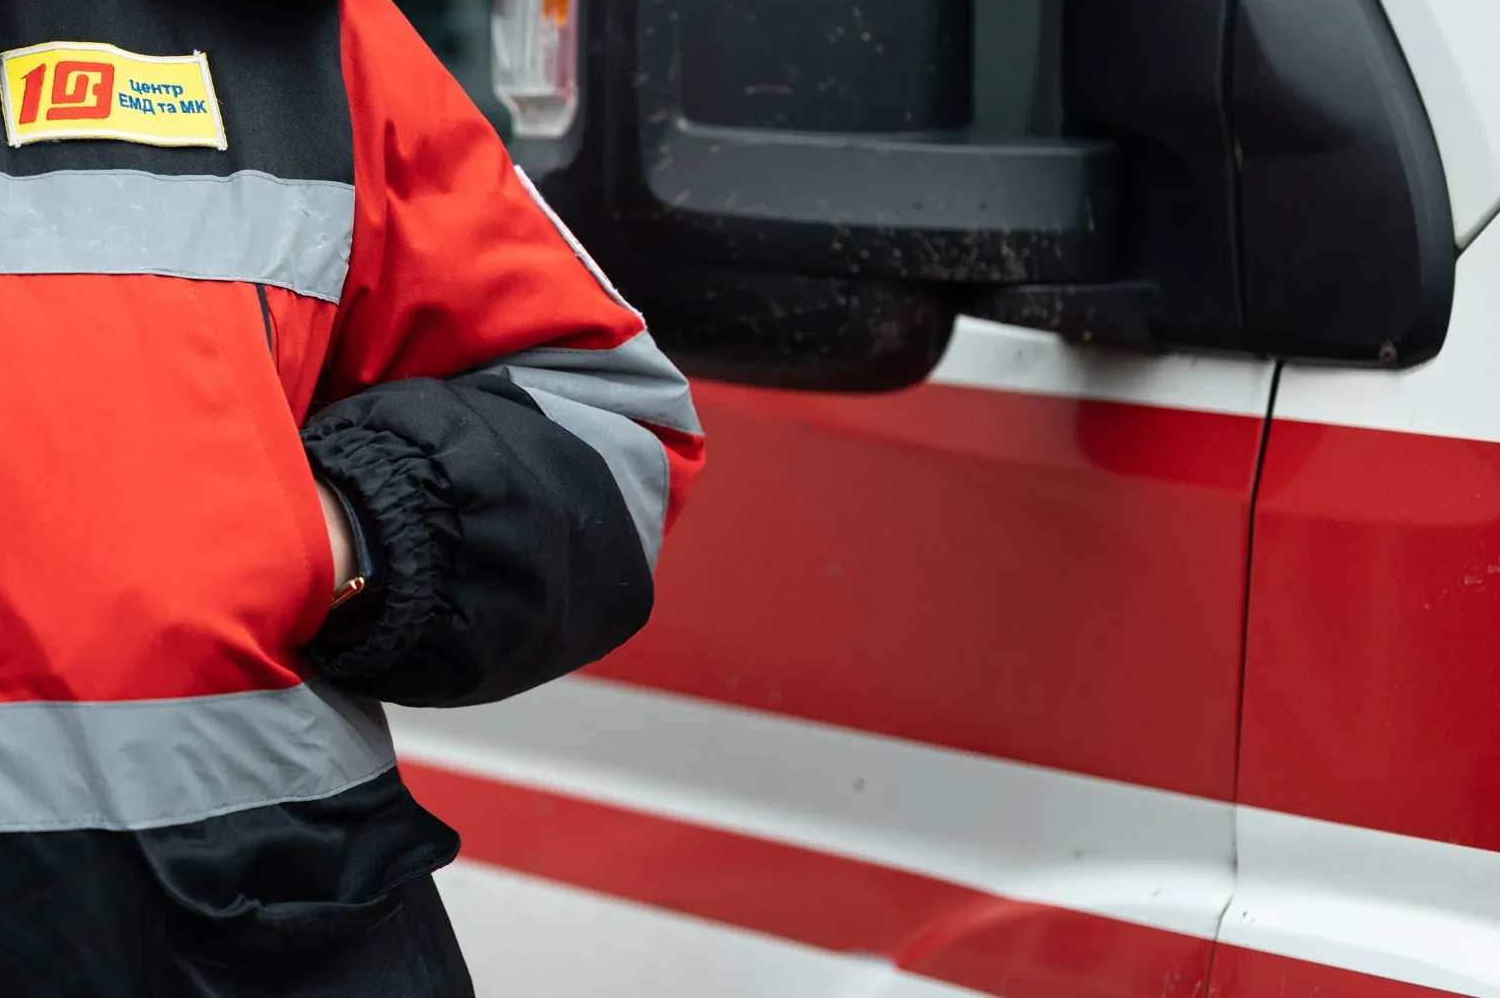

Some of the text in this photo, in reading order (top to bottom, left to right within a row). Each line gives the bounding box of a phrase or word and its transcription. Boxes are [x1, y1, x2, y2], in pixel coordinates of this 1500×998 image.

[118, 92, 208, 115] ЕМД та МК
